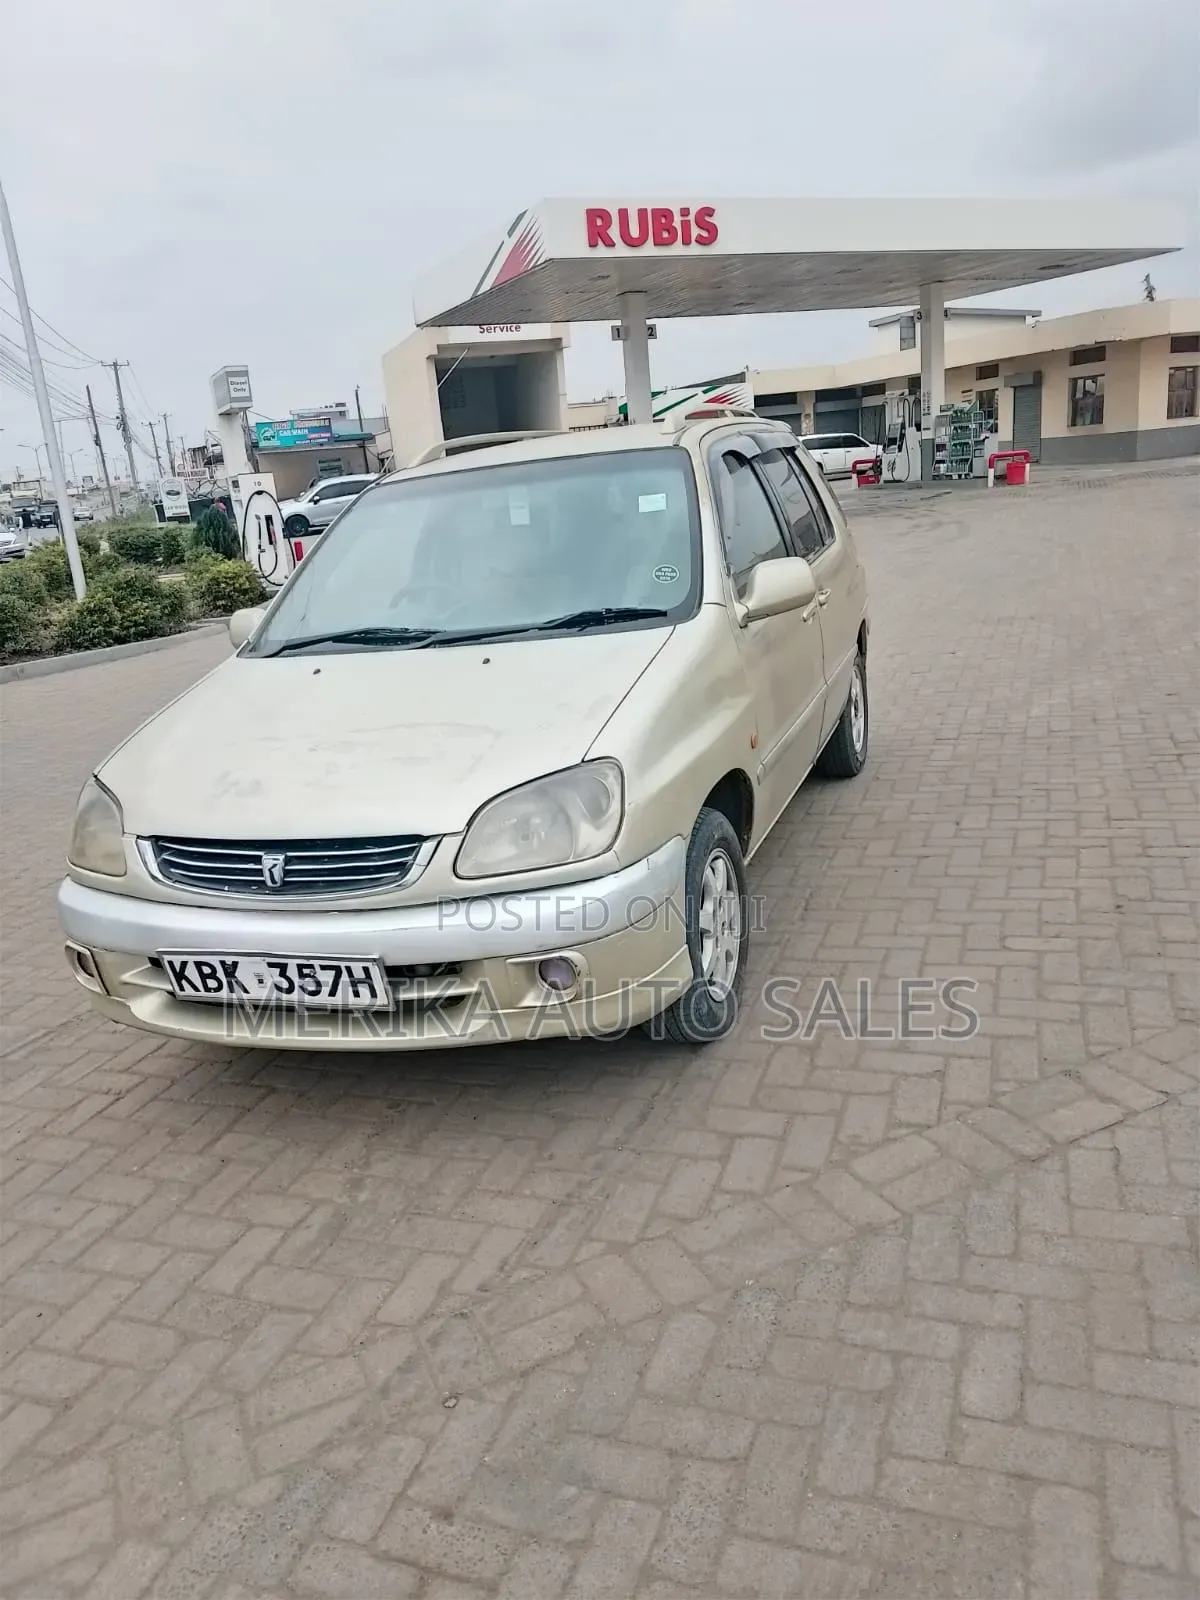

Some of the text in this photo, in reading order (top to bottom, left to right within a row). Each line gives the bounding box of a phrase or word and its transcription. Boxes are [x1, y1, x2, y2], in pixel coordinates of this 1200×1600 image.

[585, 206, 719, 248] RUBiS
[916, 311, 922, 320] 3
[479, 324, 521, 334] Service
[648, 326, 655, 337] 2
[166, 959, 251, 995] KBK
[266, 961, 379, 999] 357H
